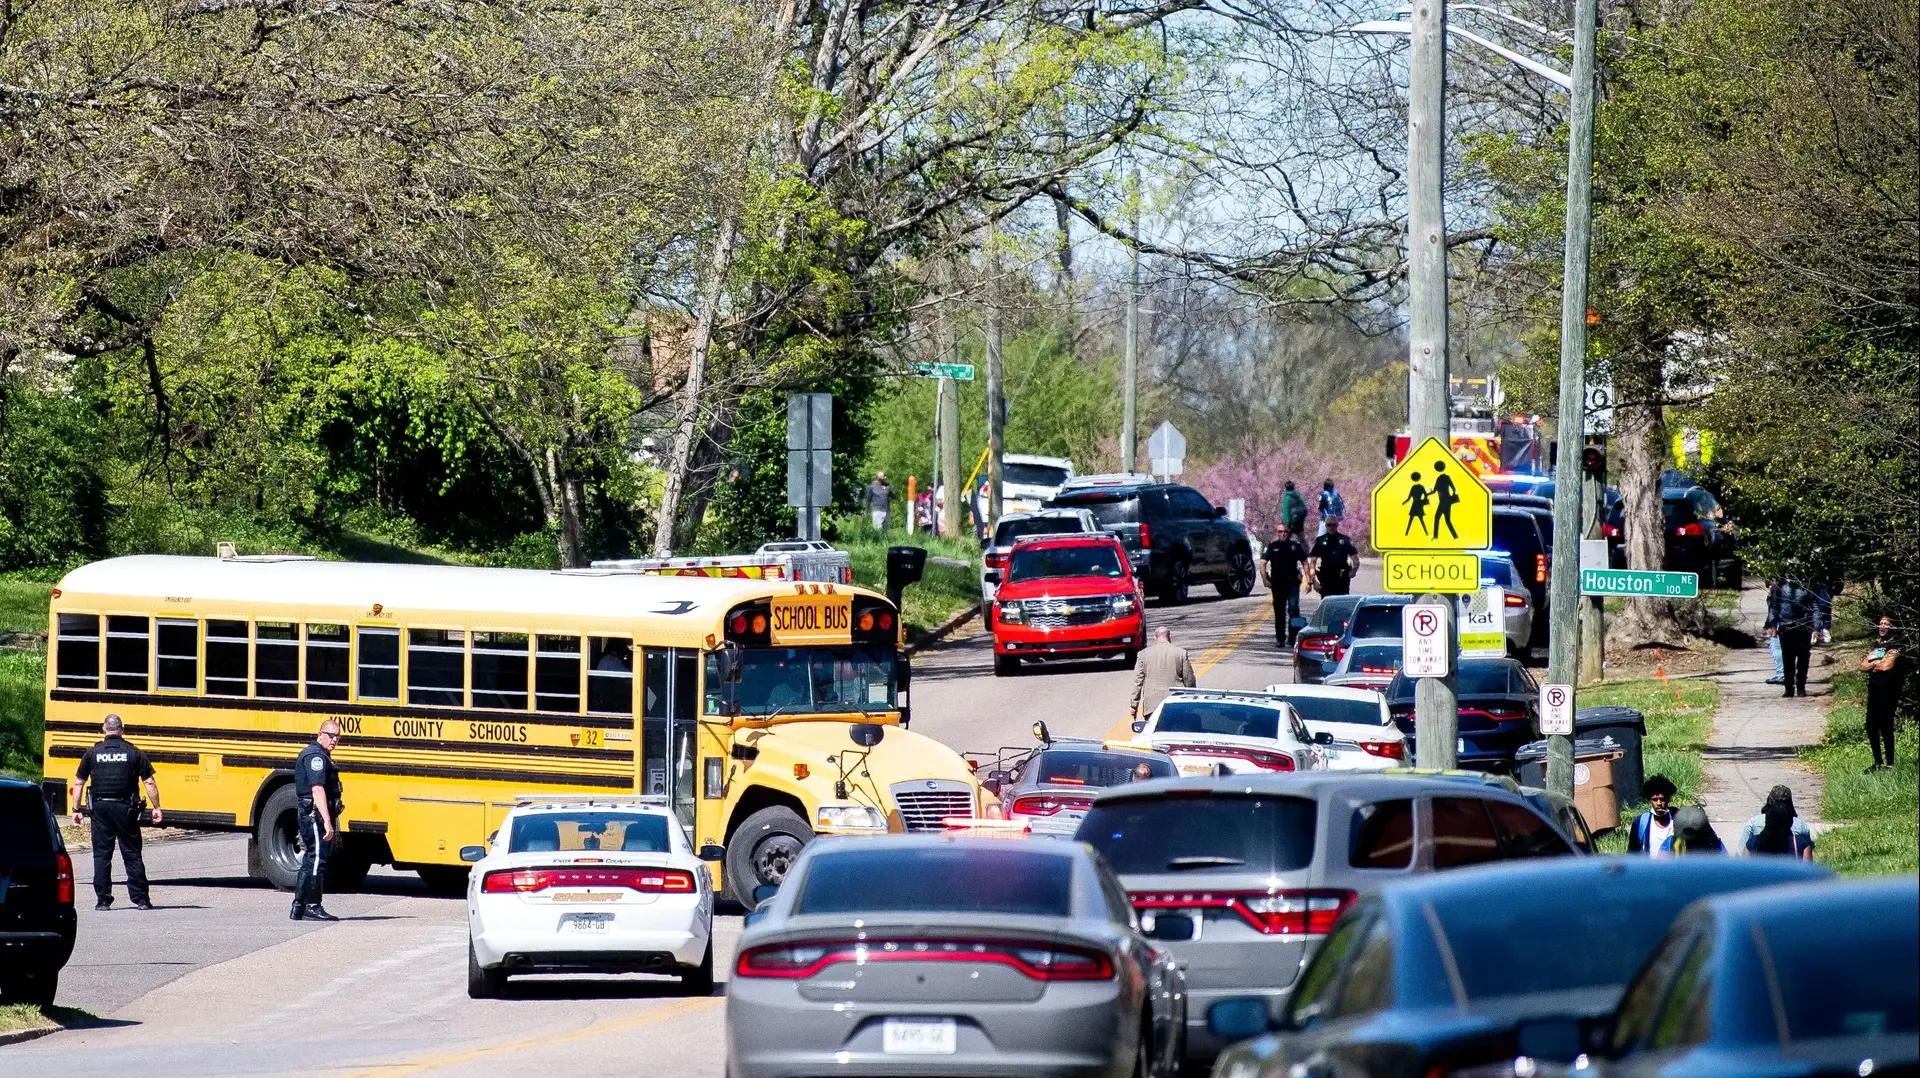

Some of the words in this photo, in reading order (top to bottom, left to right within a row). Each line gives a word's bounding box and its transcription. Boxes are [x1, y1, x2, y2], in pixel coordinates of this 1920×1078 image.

[1393, 564, 1474, 580] SCHOOL
[1585, 572, 1653, 592] Houston
[1655, 574, 1666, 583] ST
[1681, 575, 1693, 585] NE
[1666, 585, 1681, 594] 100
[774, 605, 820, 630] SCHOOL
[824, 605, 848, 629] BUS
[1468, 611, 1494, 624] kat
[1418, 646, 1433, 654] TIME
[1409, 655, 1421, 664] TOW
[1424, 655, 1442, 663] AWAY
[1418, 664, 1433, 673] ZONE
[393, 719, 444, 738] COUNTY
[469, 723, 527, 743] SCHOOLS
[586, 730, 598, 745] 32
[96, 753, 128, 762] POLICE
[552, 892, 624, 902] SHERIFF
